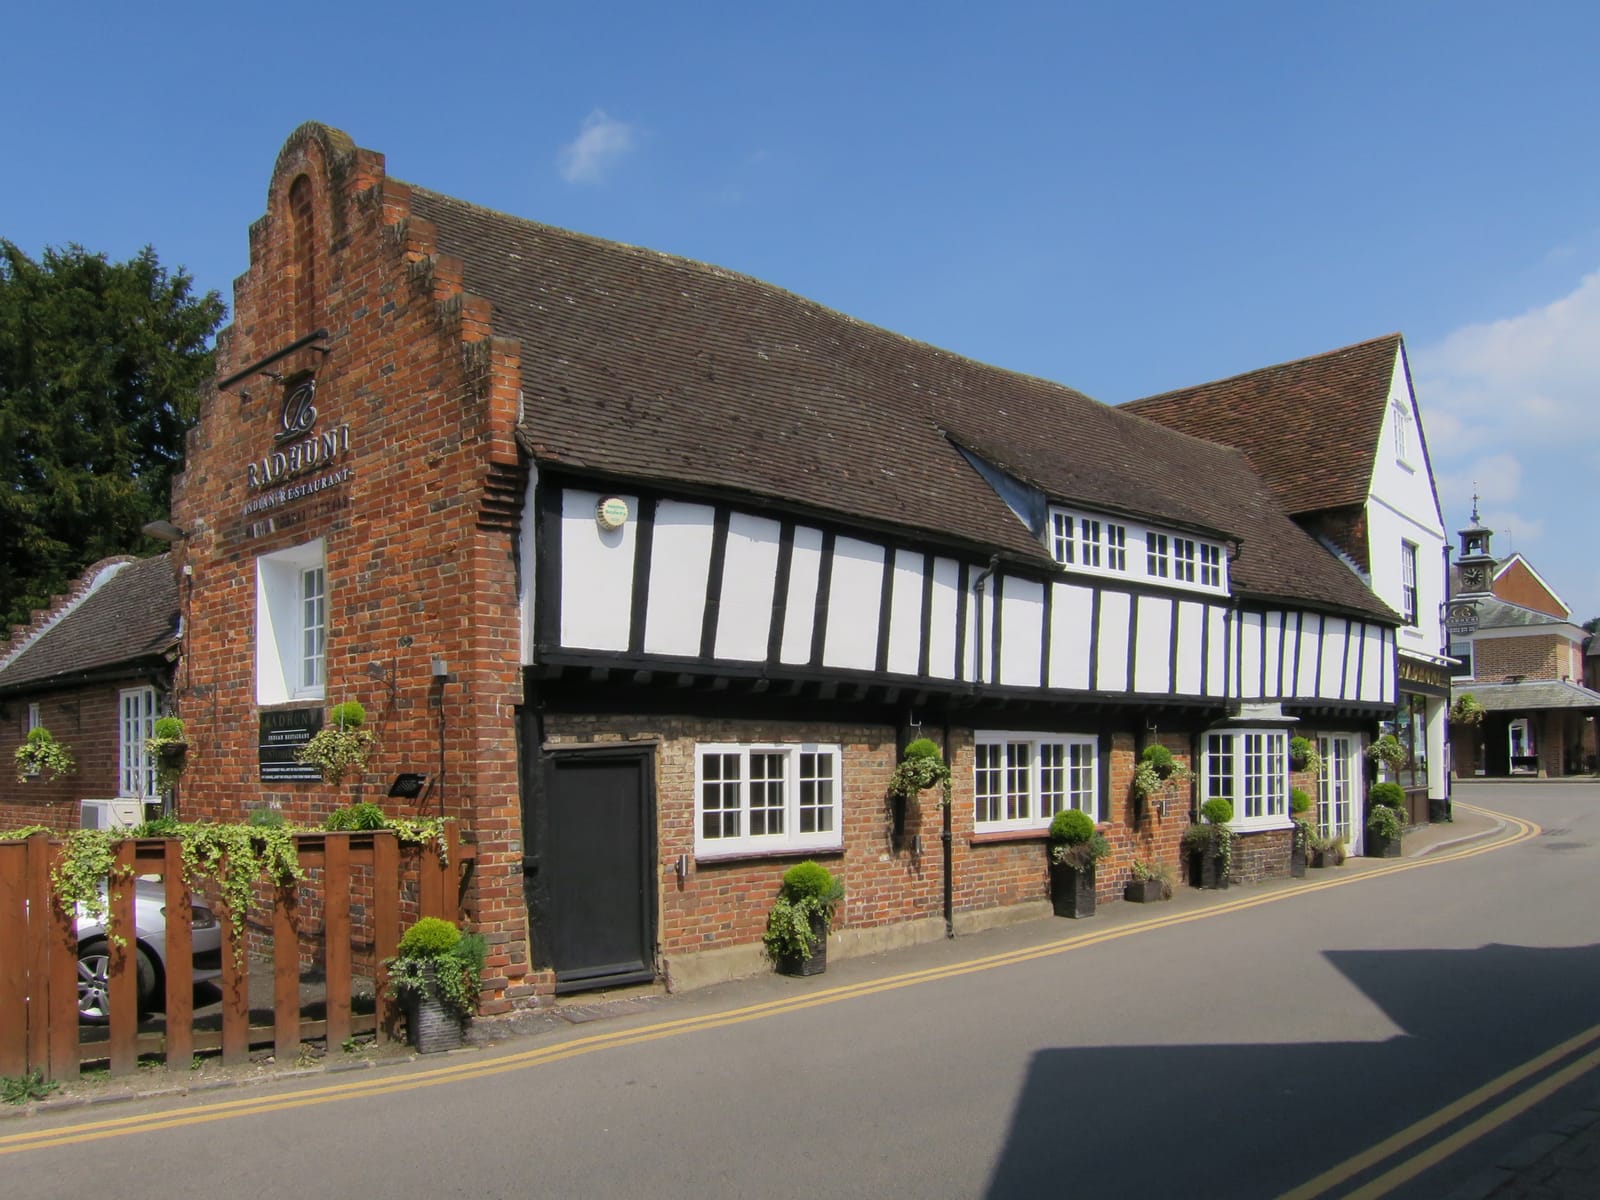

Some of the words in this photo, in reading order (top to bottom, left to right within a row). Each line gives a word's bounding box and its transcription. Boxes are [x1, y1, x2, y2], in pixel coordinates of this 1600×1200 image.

[248, 424, 349, 487] RADHUNI
[243, 493, 276, 516] INDIAN
[280, 468, 348, 503] RESTAURANT
